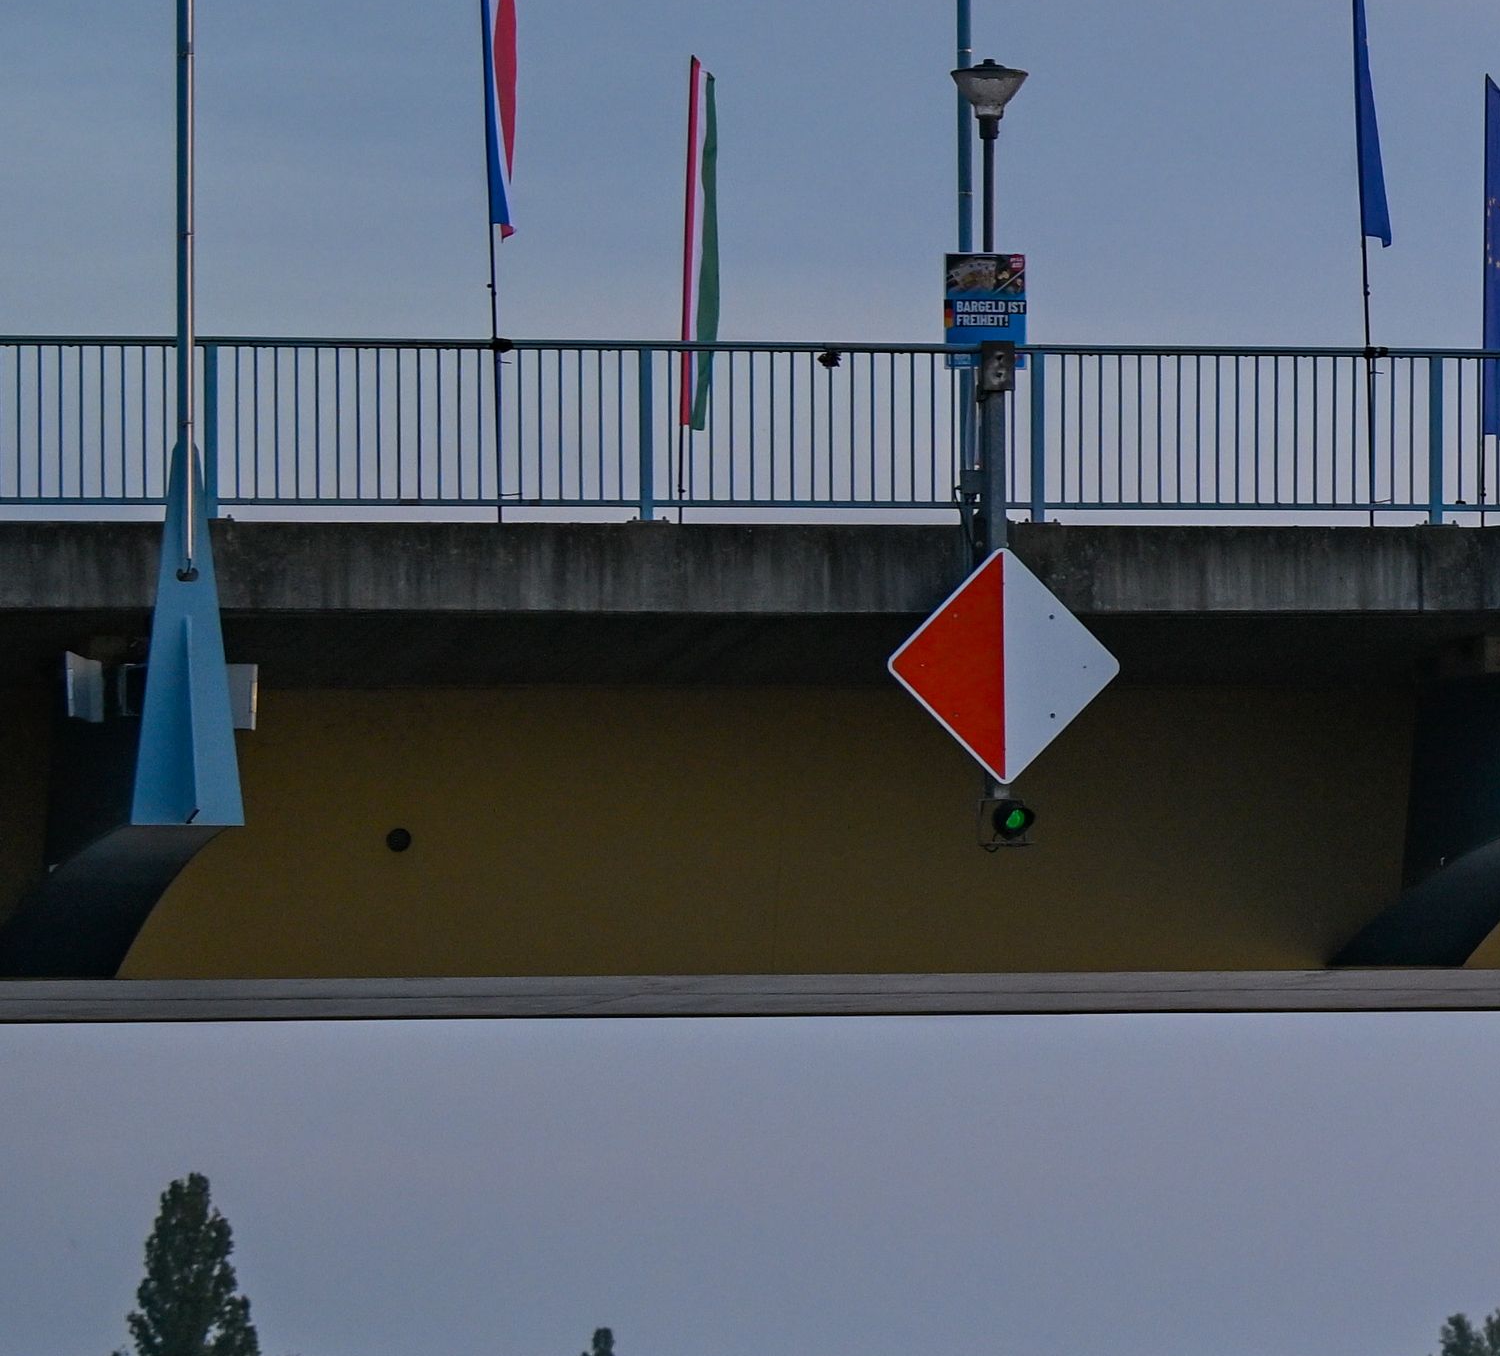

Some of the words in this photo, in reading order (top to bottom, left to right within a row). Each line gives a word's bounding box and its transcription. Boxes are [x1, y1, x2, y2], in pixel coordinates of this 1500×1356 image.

[957, 301, 1005, 313] BARGELD
[1008, 301, 1025, 313] IST
[957, 315, 1008, 326] FREIHEIT!
